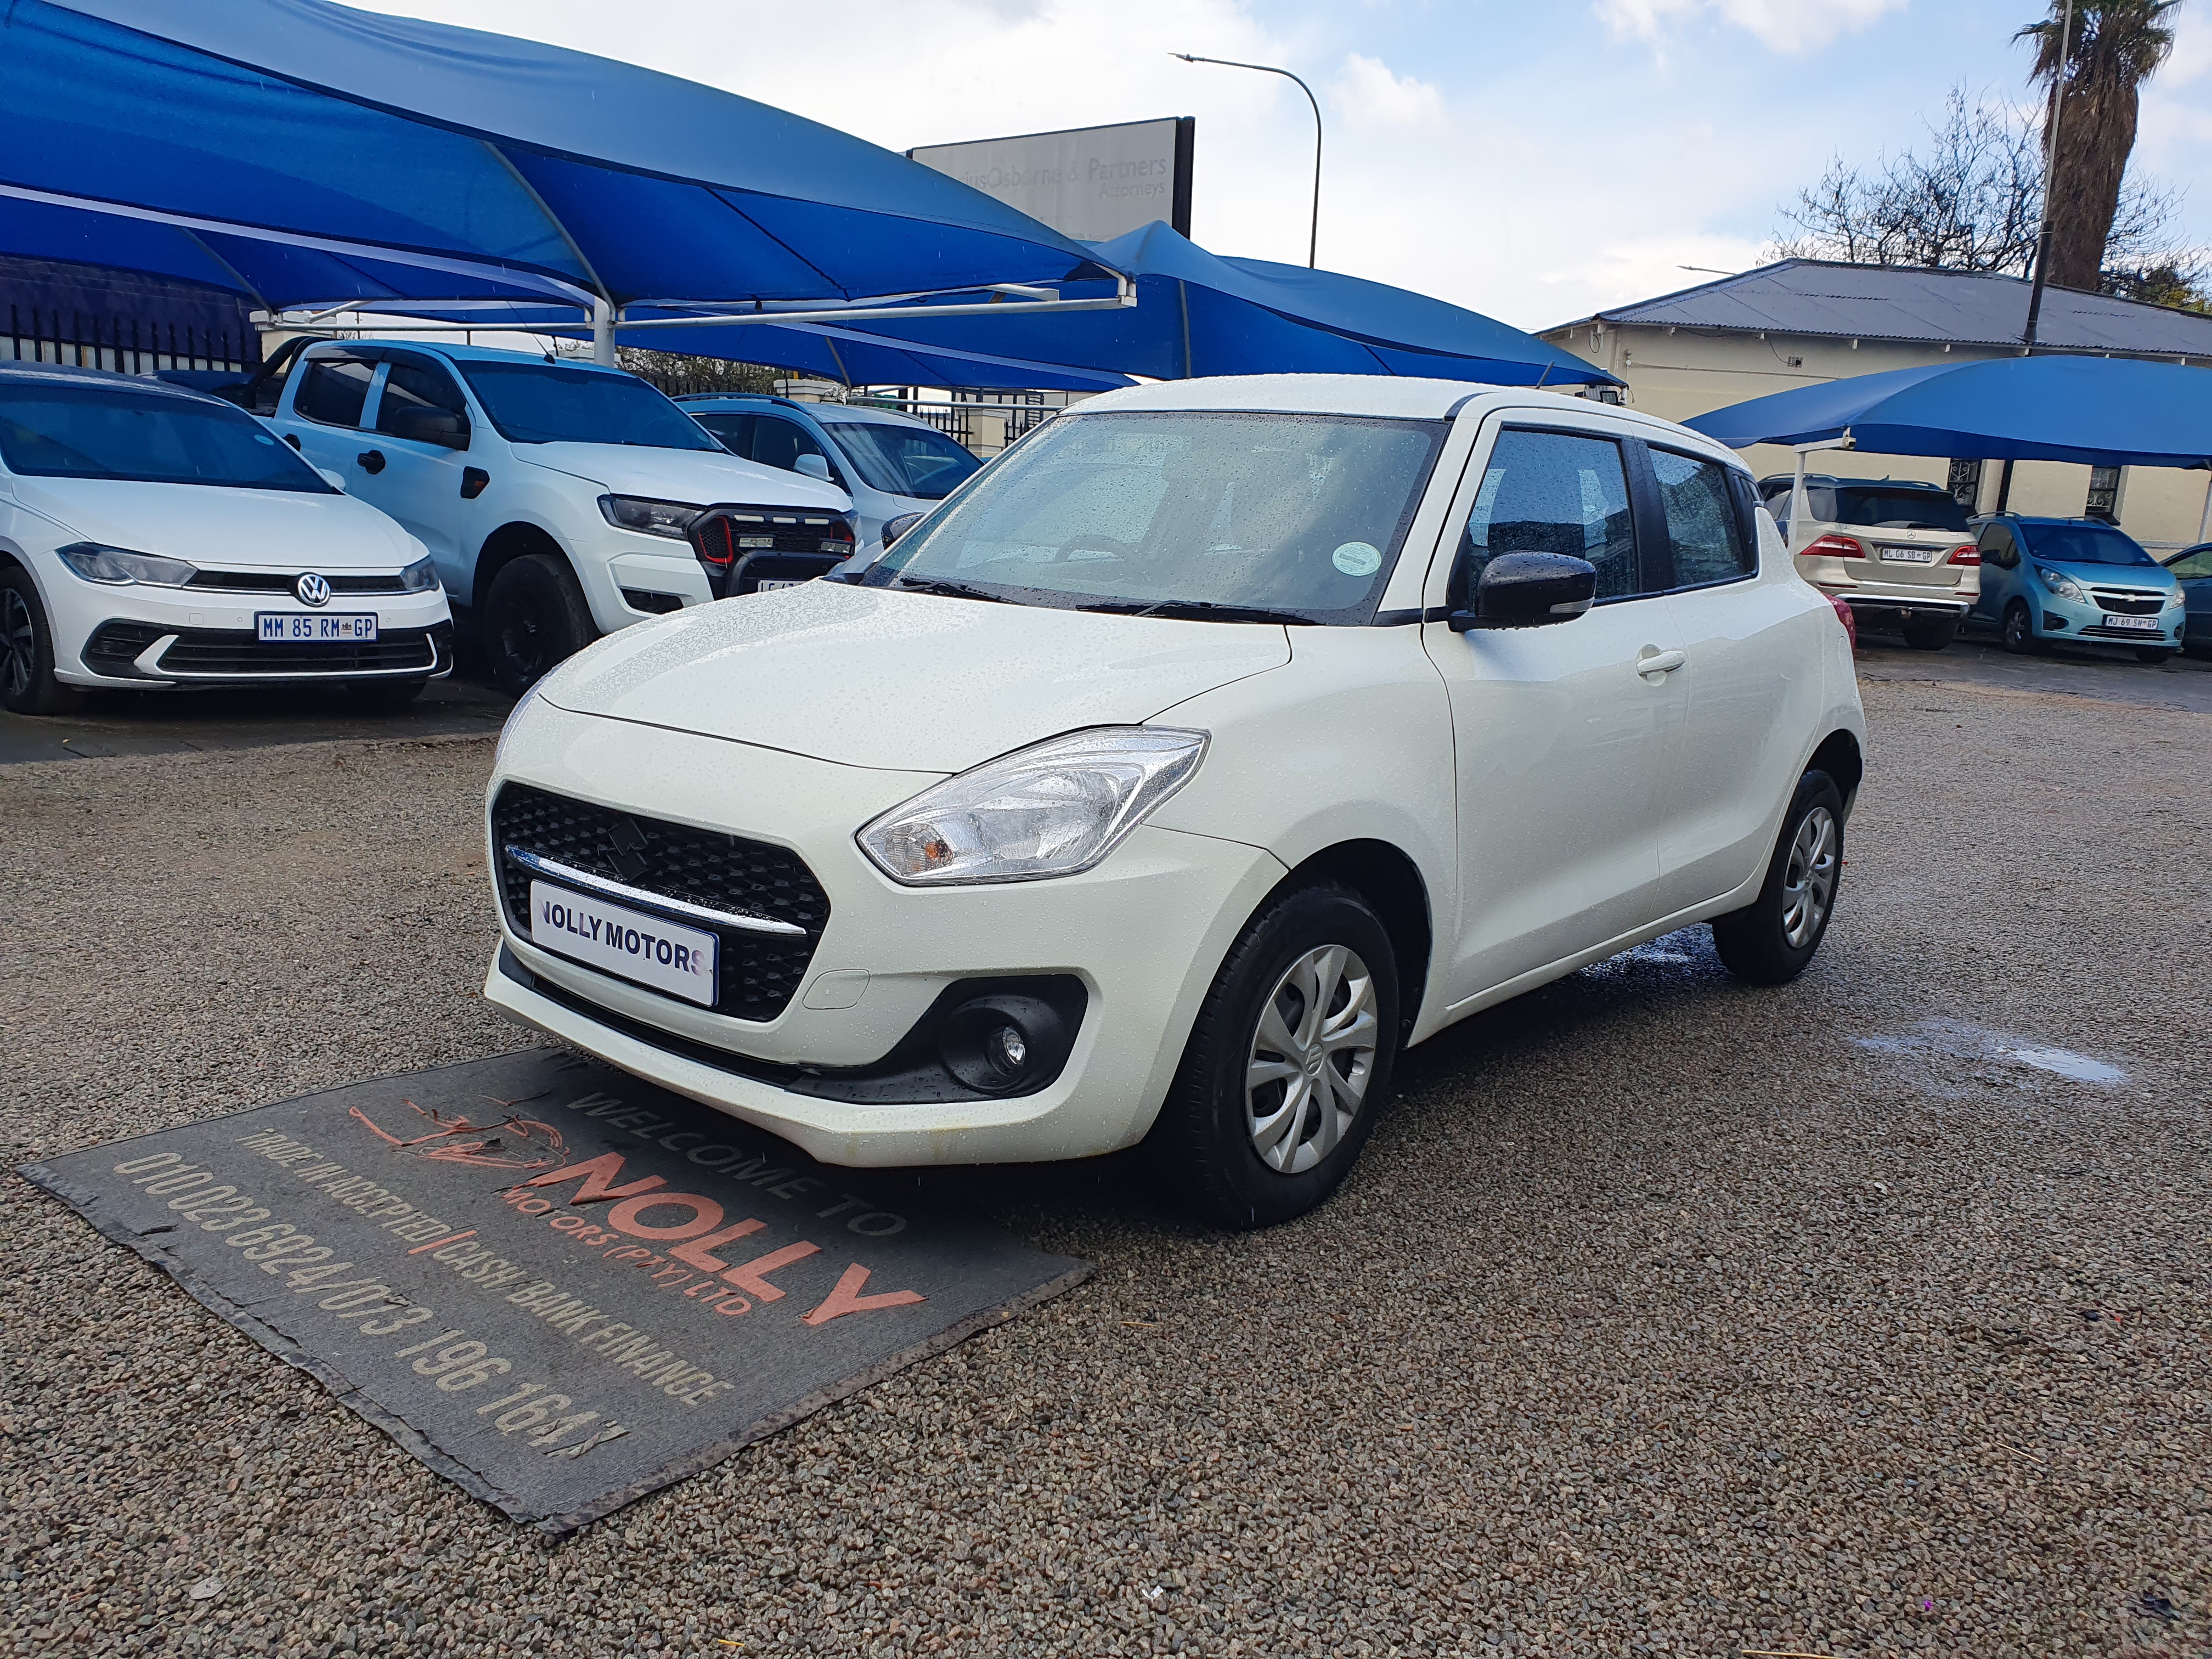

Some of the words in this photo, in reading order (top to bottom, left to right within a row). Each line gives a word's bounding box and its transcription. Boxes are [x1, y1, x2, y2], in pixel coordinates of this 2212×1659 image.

[1088, 157, 1166, 181] Partners
[1098, 182, 1165, 200] Attorneys
[1884, 549, 1893, 558] ML
[1907, 550, 1916, 559] SB
[1922, 551, 1931, 560] GP
[263, 618, 284, 637] MM
[292, 618, 312, 637] 85
[321, 618, 340, 637] RM
[354, 618, 373, 639] GP
[2108, 617, 2118, 625] MJ
[2121, 618, 2131, 627] 69
[2134, 619, 2142, 627] SN
[2147, 620, 2157, 628] GP
[538, 898, 602, 941] NOLLY
[606, 921, 706, 977] MOTORS
[567, 1092, 825, 1199] WELCOME
[816, 1193, 907, 1236] TO
[510, 1152, 928, 1326] NOLLY
[113, 1152, 215, 1195] 010
[167, 1184, 272, 1231] 023
[394, 1327, 512, 1392] 196
[235, 1128, 325, 1168] TRADE
[293, 1161, 348, 1182] IN
[579, 1322, 735, 1406] FINANCE
[684, 1280, 752, 1316] LTD
